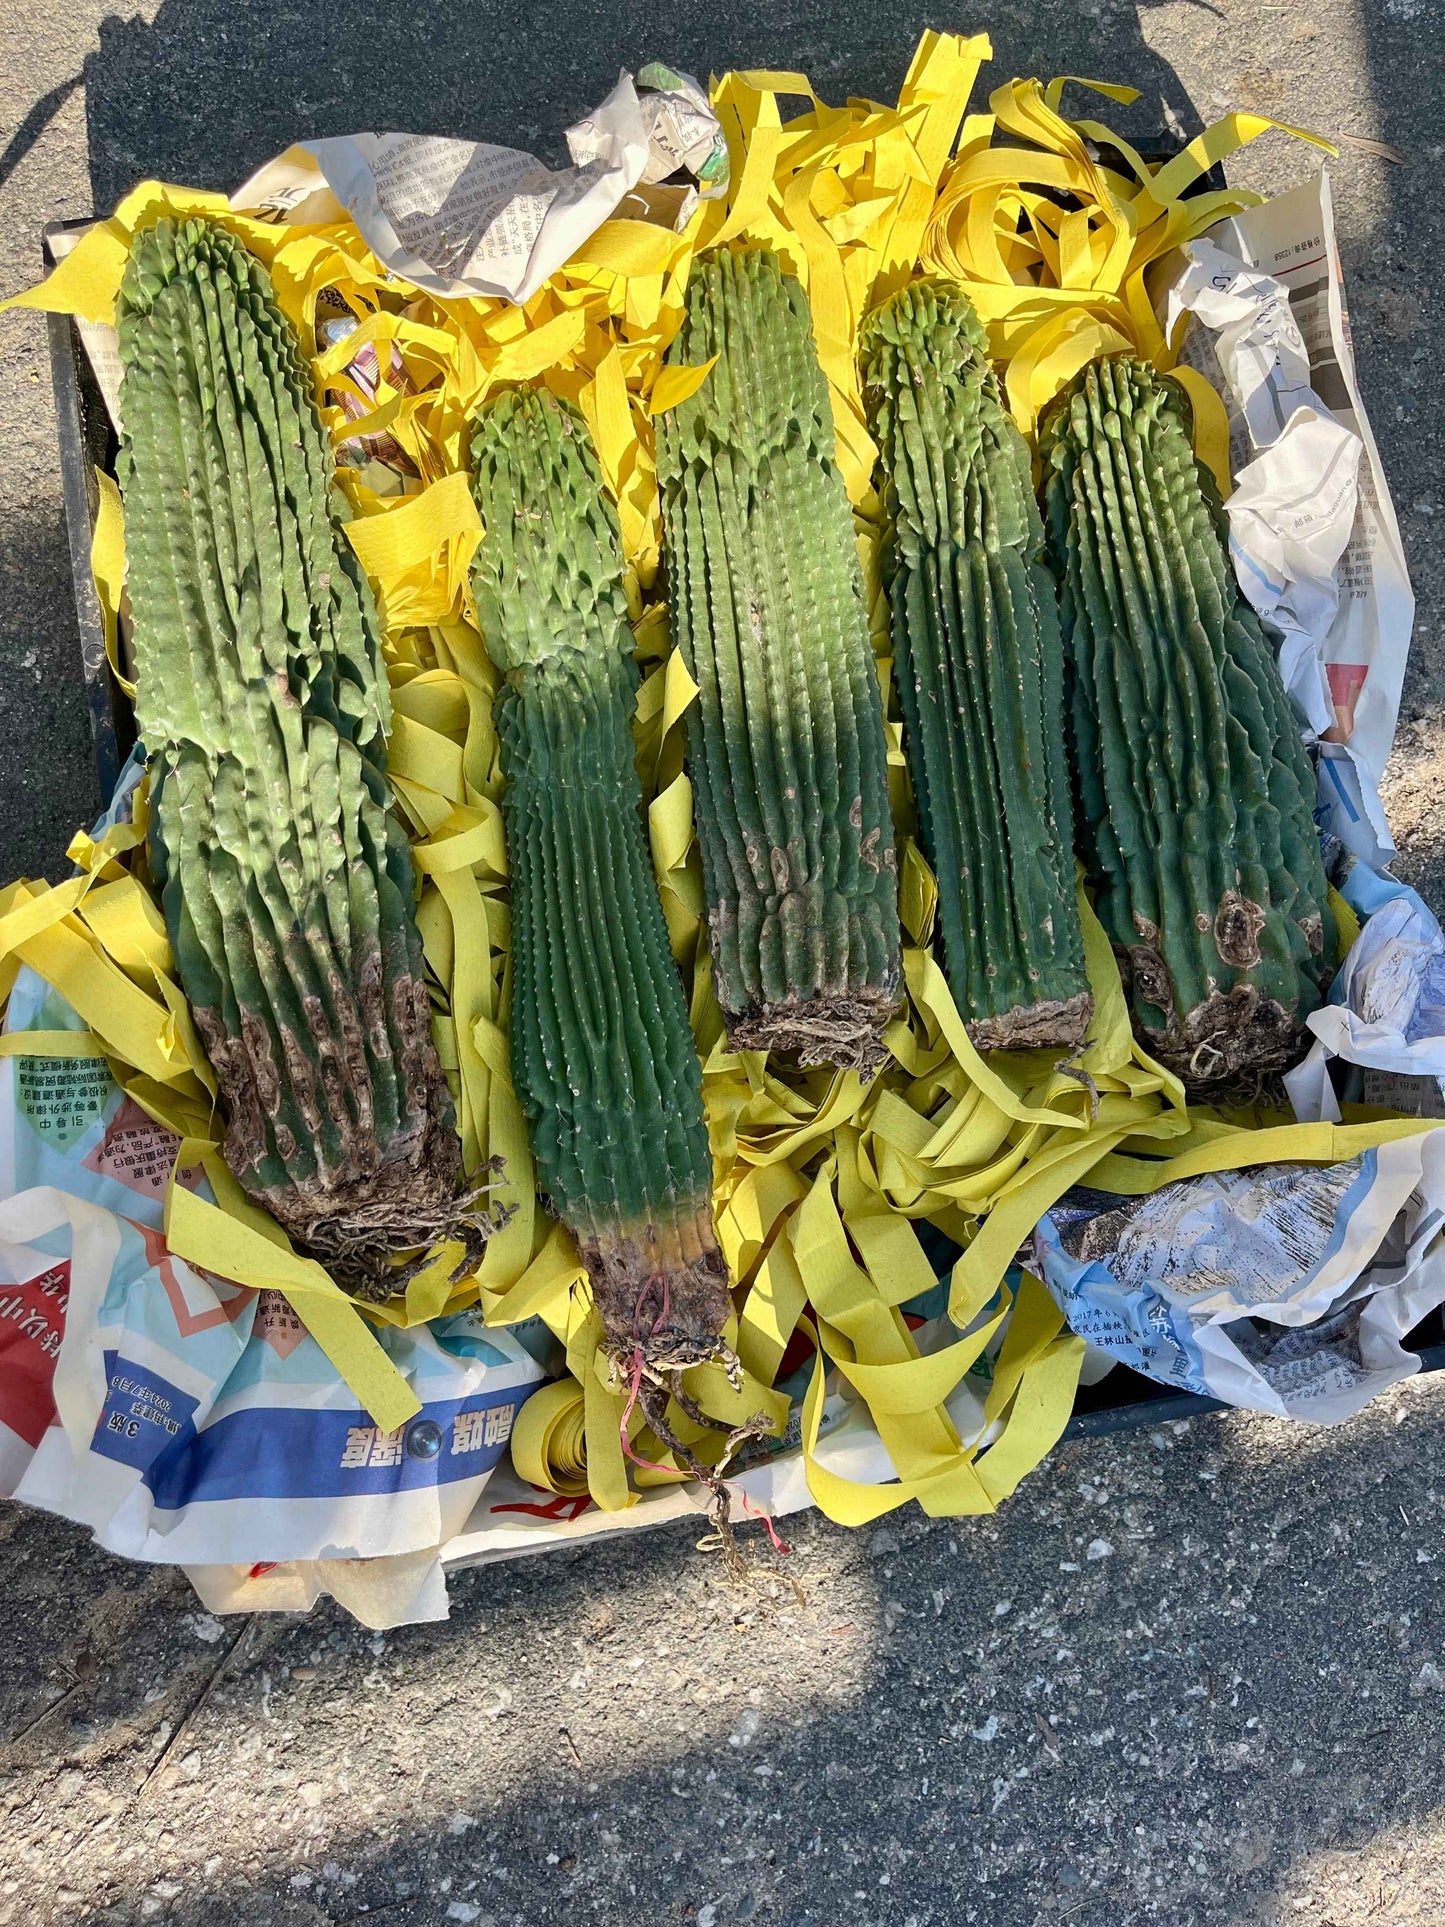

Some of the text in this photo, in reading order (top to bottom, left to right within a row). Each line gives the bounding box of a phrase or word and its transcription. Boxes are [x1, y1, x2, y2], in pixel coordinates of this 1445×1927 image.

[26, 1101, 98, 1115] 豪等涉外律所
[39, 1115, 84, 1130] 引导中
[112, 1126, 164, 1142] 发放融资
[98, 1135, 180, 1161] E融”产品，为通
[151, 1170, 192, 1187] 创通
[255, 1304, 297, 1319] 海新通
[107, 1411, 140, 1439] 3版
[340, 1403, 515, 1468] 融媒 深度
